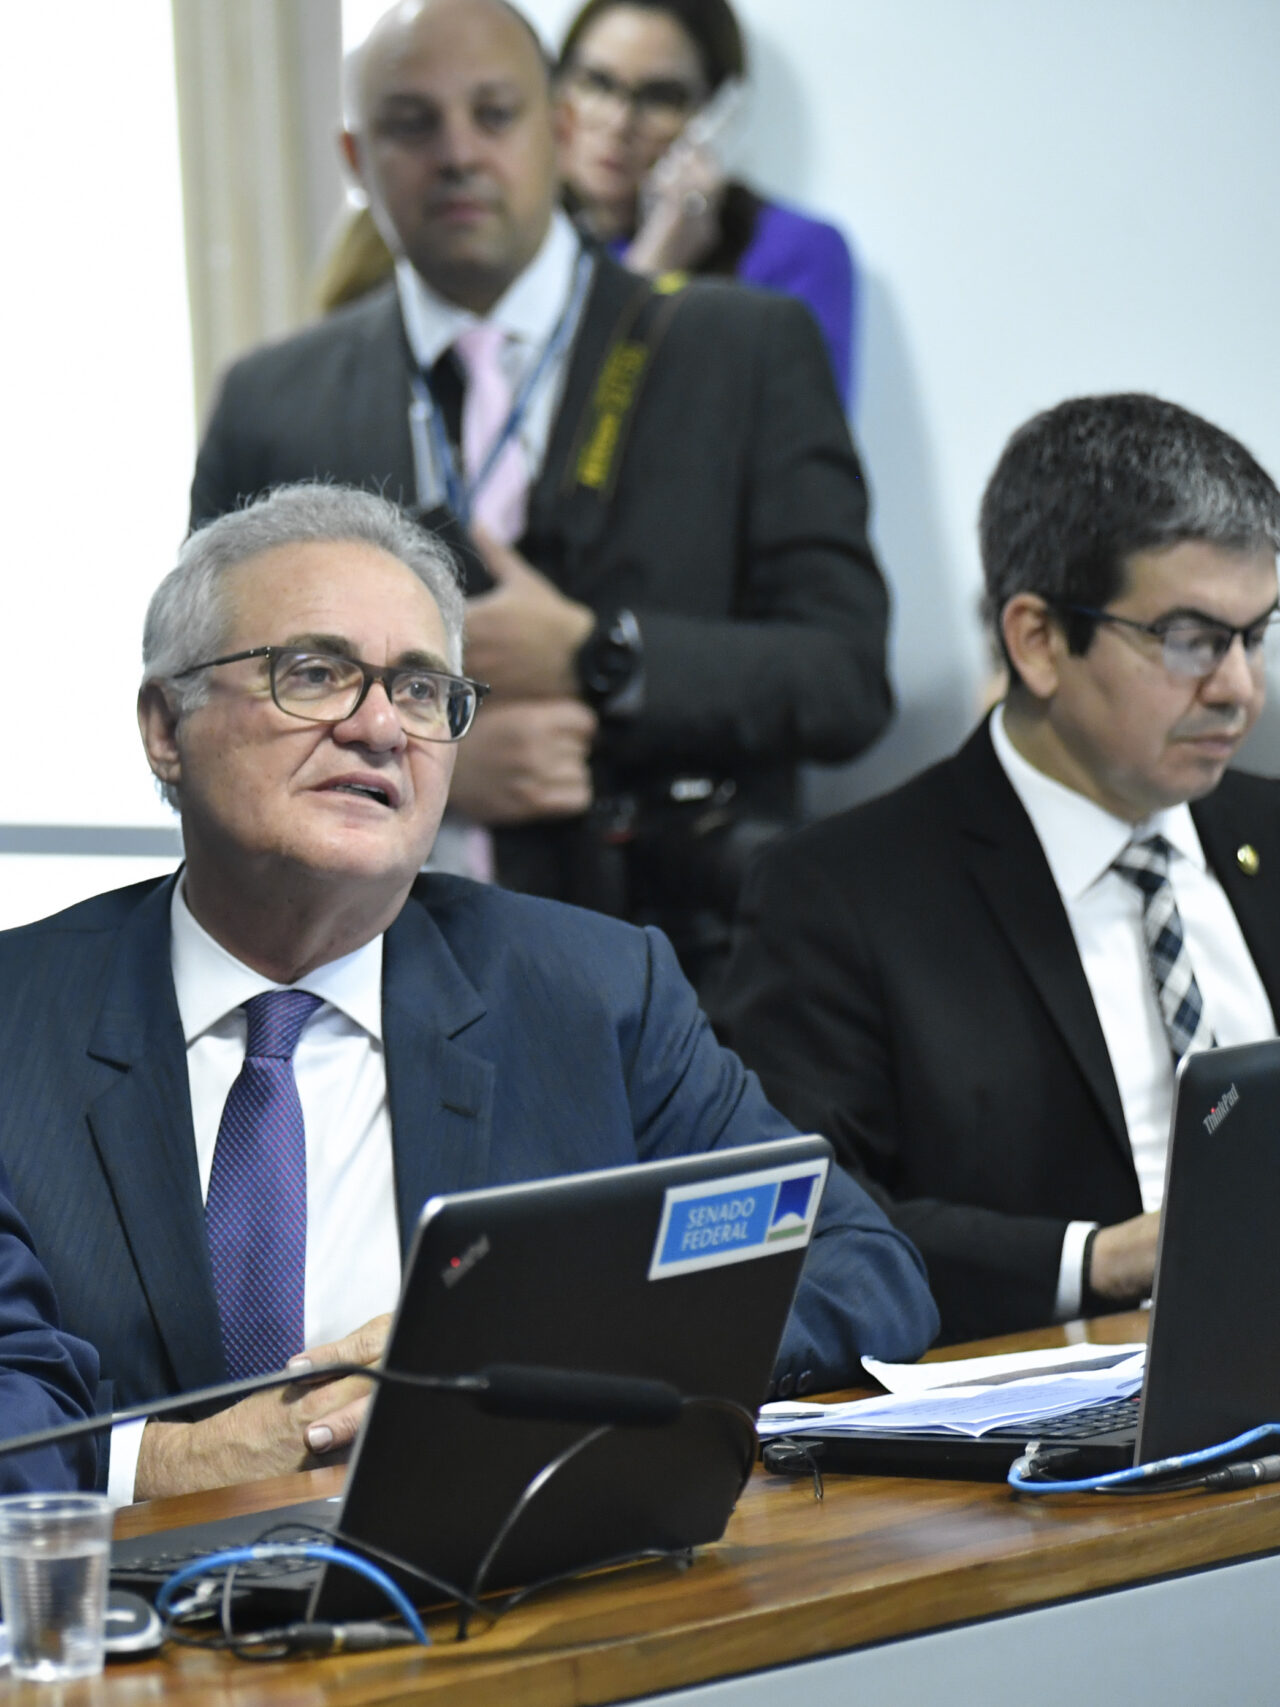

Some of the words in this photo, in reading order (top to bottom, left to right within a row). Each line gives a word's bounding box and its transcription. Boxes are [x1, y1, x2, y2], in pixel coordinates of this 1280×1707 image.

[1202, 1082, 1239, 1135] ThinkPad
[687, 1197, 755, 1229] SENADO
[681, 1221, 749, 1251] FEDERAL
